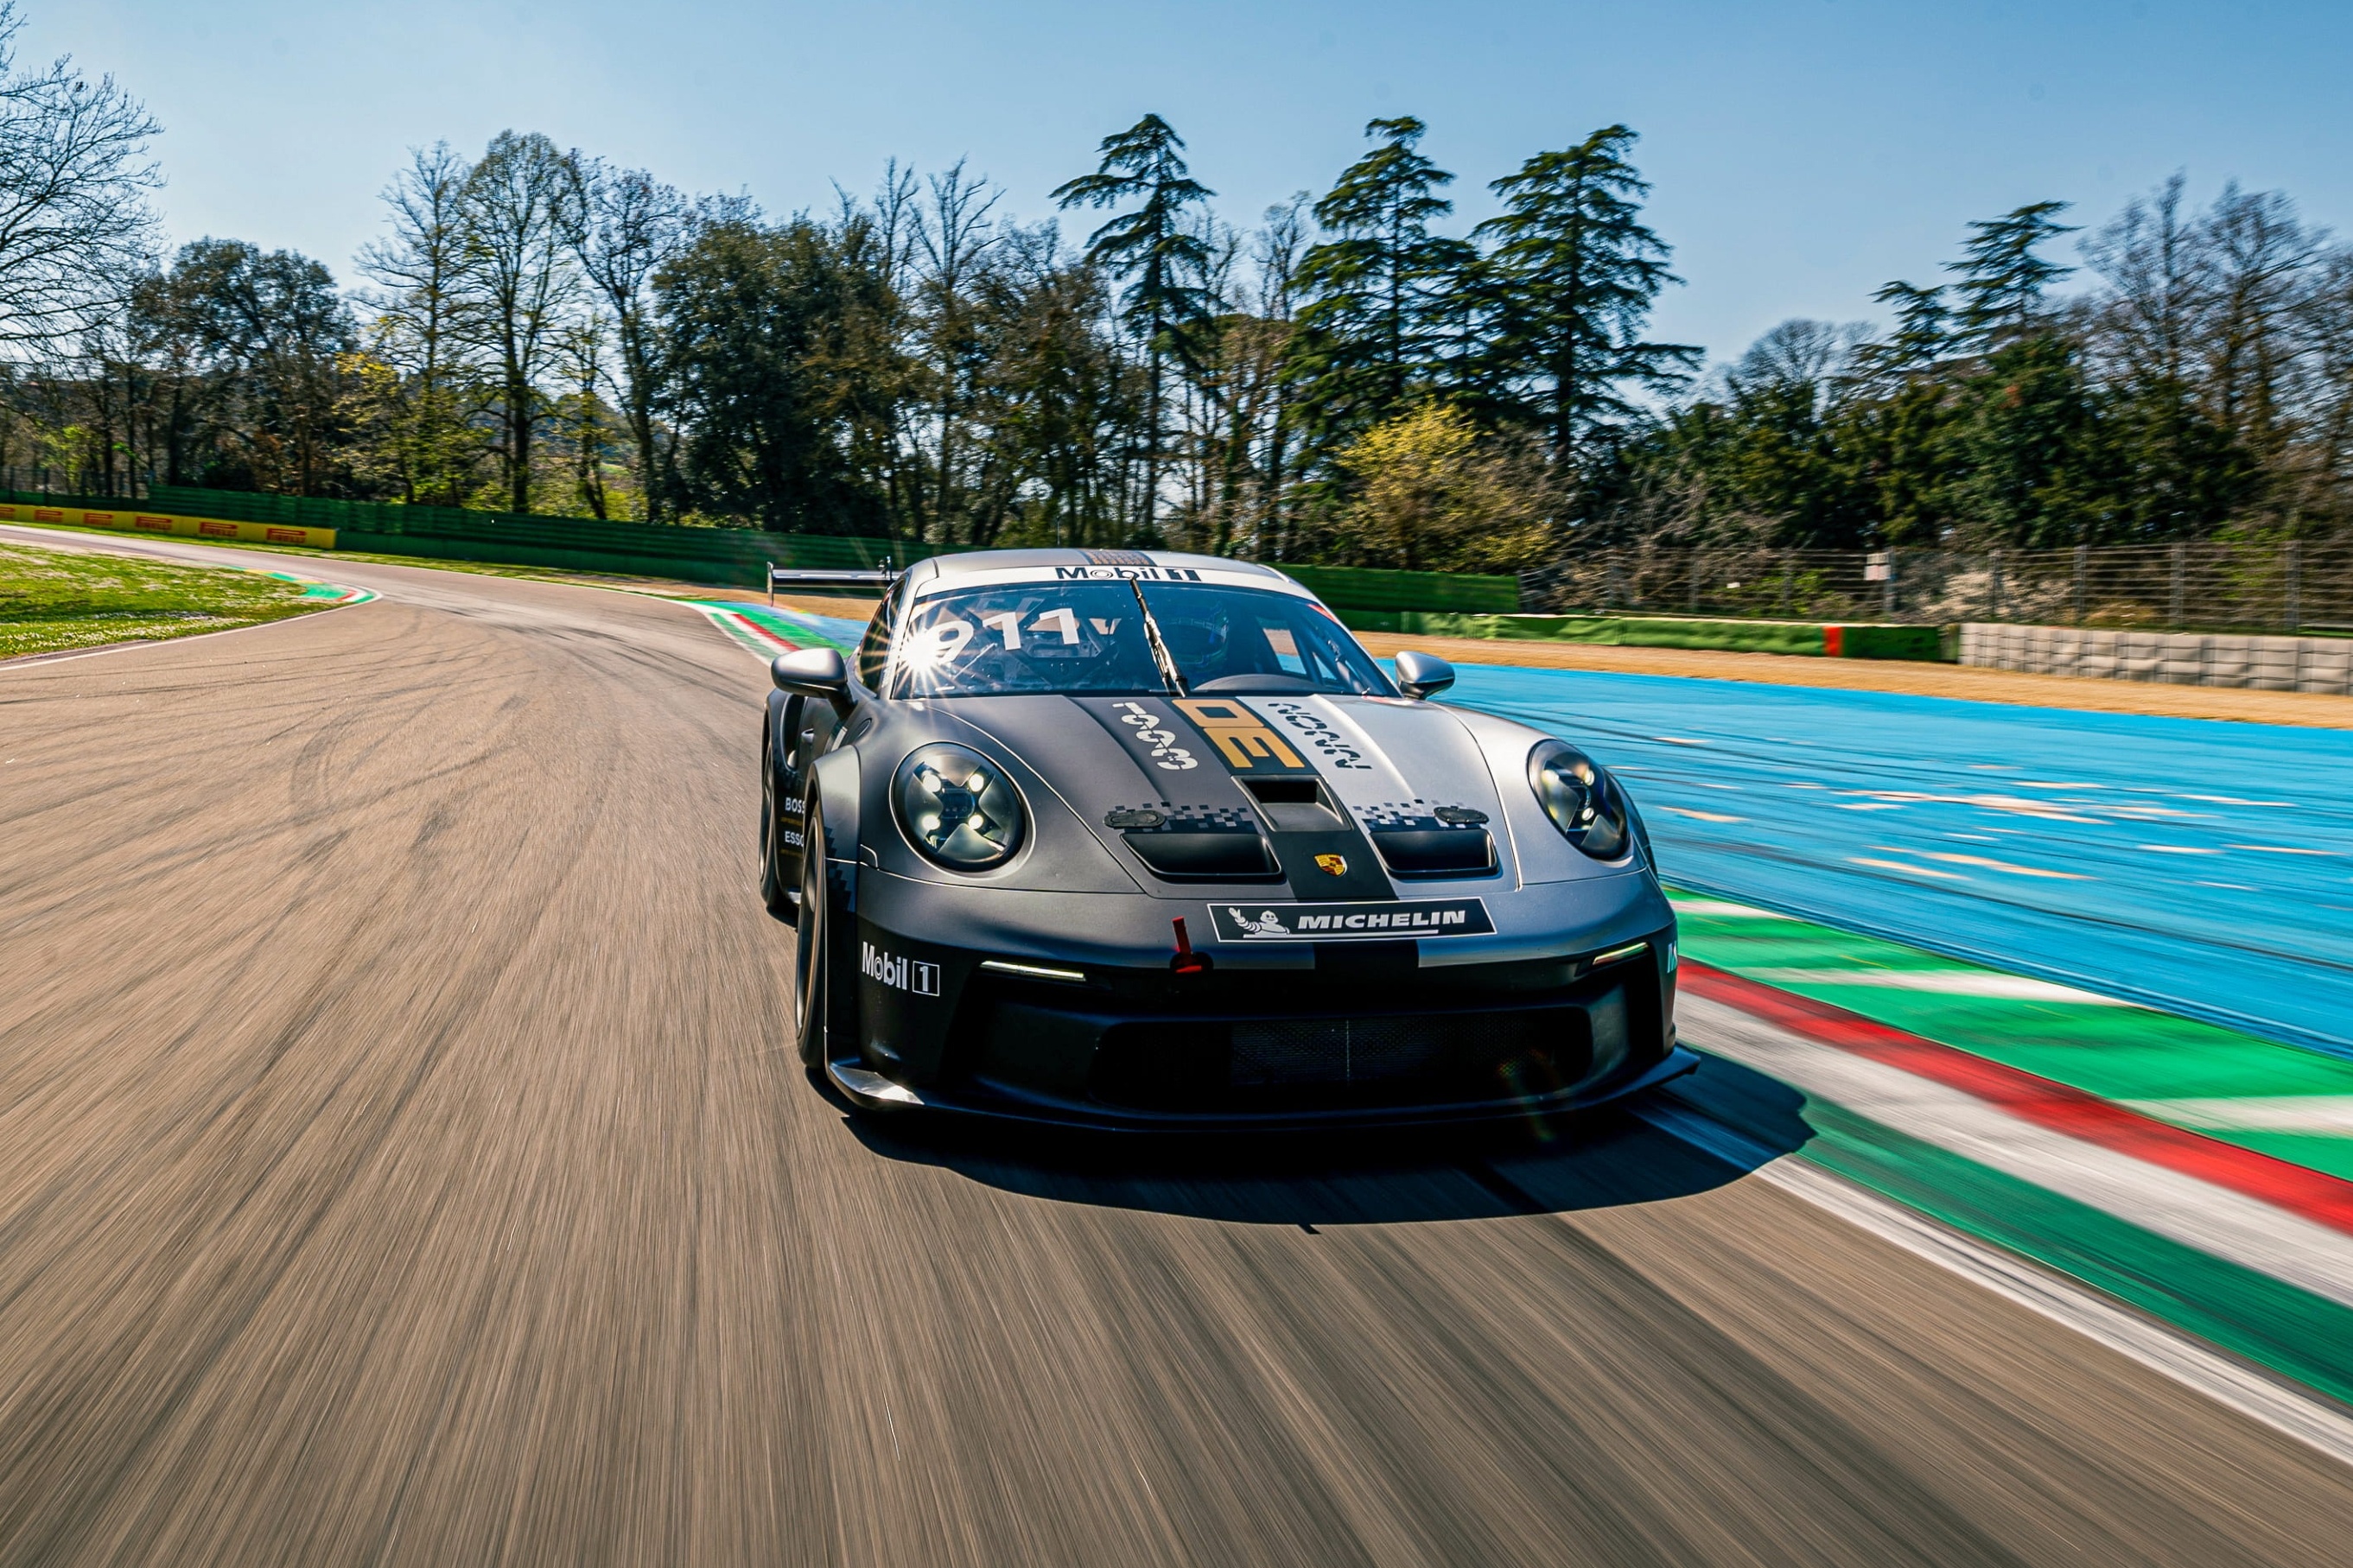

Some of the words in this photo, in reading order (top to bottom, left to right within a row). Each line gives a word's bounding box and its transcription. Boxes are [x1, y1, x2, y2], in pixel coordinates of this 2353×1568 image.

[1055, 567, 1161, 581] Mobil
[922, 607, 1080, 664] 911
[785, 797, 804, 815] BOSS
[1296, 910, 1466, 930] MICHELIN
[862, 940, 907, 991] Mobil
